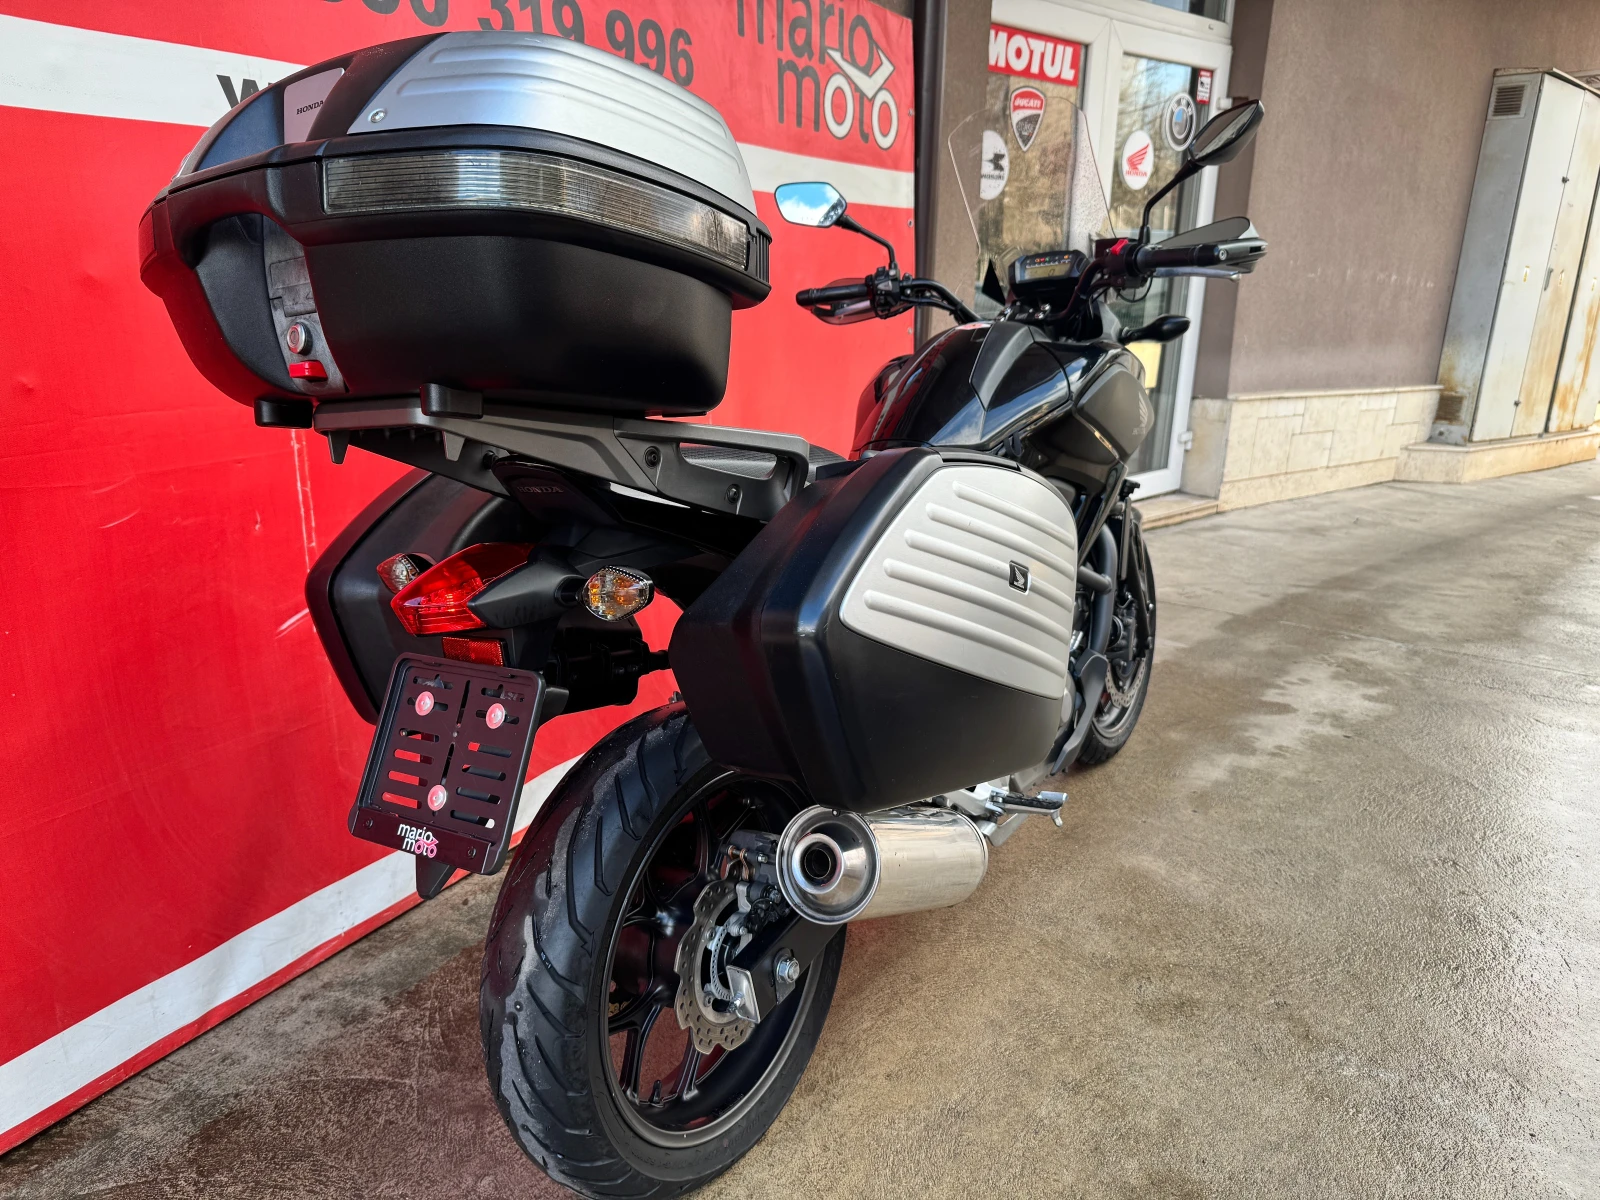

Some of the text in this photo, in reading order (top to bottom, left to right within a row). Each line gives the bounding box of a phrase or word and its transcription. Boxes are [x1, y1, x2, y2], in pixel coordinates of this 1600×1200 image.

[605, 9, 694, 86] 996
[989, 29, 1075, 81] MOTUL
[296, 100, 324, 115] HONDA
[777, 58, 898, 150] moto
[1014, 97, 1042, 108] DUCATI
[397, 823, 433, 843] mario
[402, 838, 437, 858] moto
